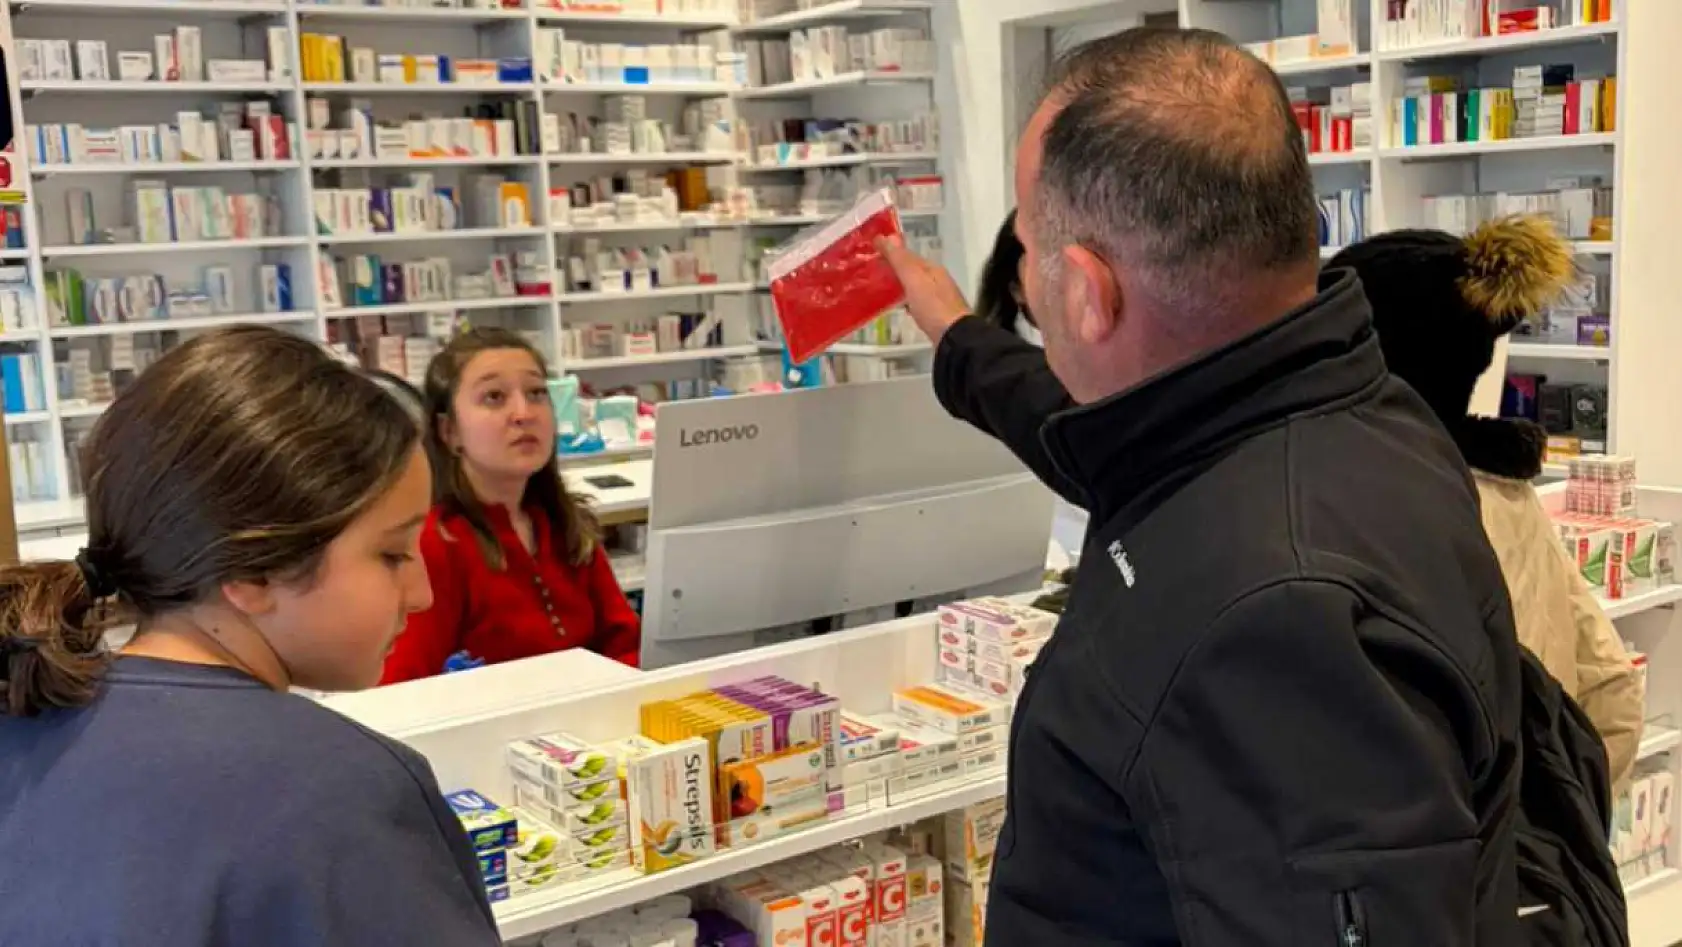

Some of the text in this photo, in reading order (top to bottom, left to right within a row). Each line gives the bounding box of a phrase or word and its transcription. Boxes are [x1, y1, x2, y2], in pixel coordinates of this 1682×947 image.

[679, 423, 759, 448] Lenovo
[683, 753, 706, 850] Strepsils
[882, 883, 905, 913] C
[842, 909, 865, 942] C
